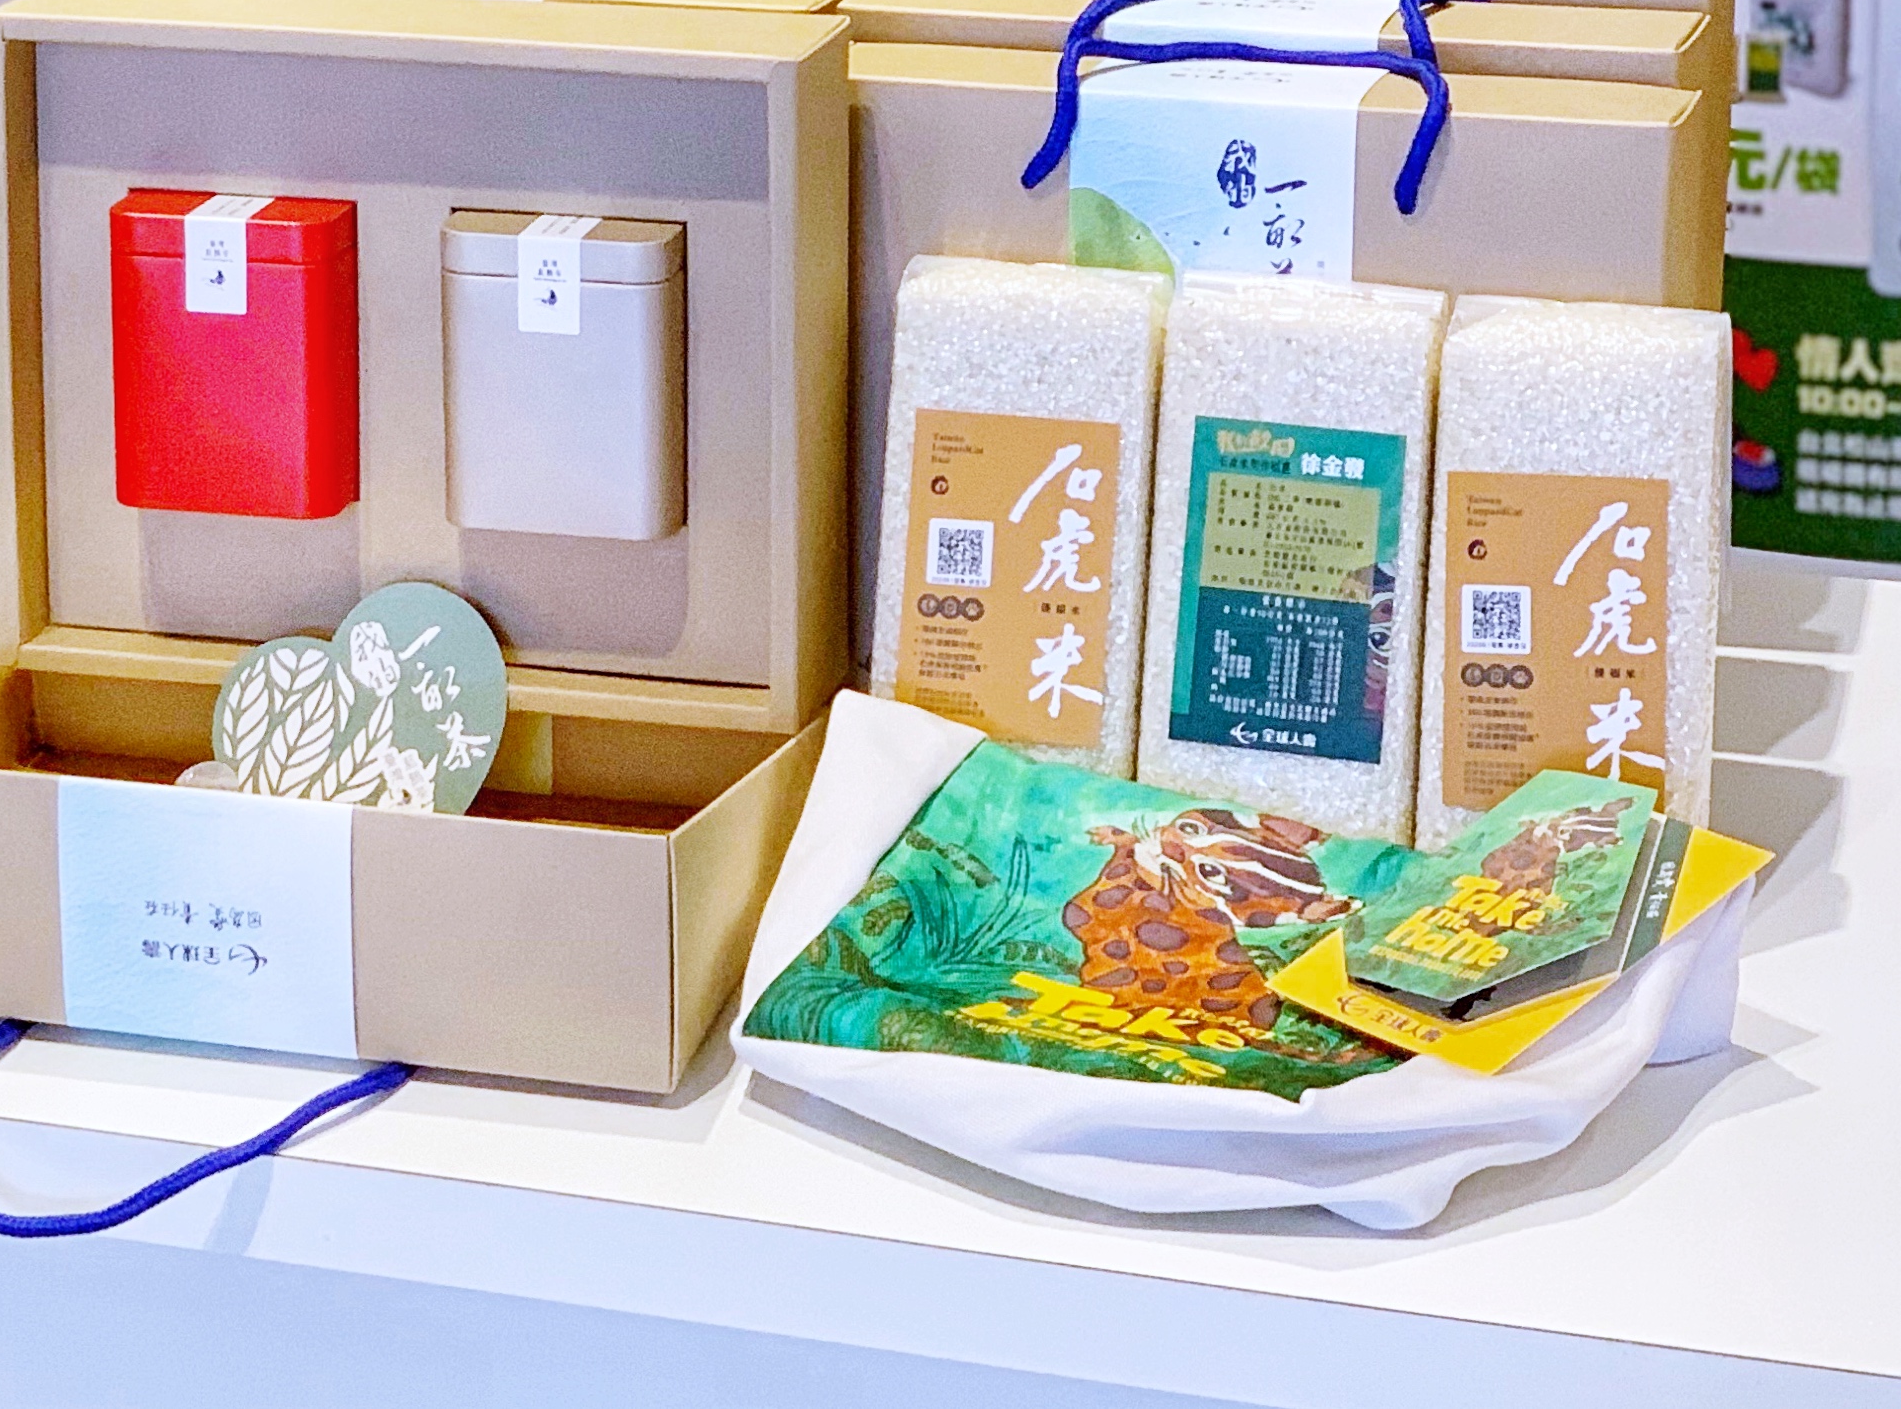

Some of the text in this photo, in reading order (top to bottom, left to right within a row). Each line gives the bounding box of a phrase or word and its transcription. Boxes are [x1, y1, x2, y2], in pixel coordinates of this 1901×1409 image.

[1264, 180, 1307, 274] 一畝
[1008, 443, 1103, 719] 石虎米
[1553, 501, 1666, 782] 石虎米
[1385, 907, 1510, 968] home
[1447, 874, 1546, 932] Take
[1010, 971, 1245, 1052] Take
